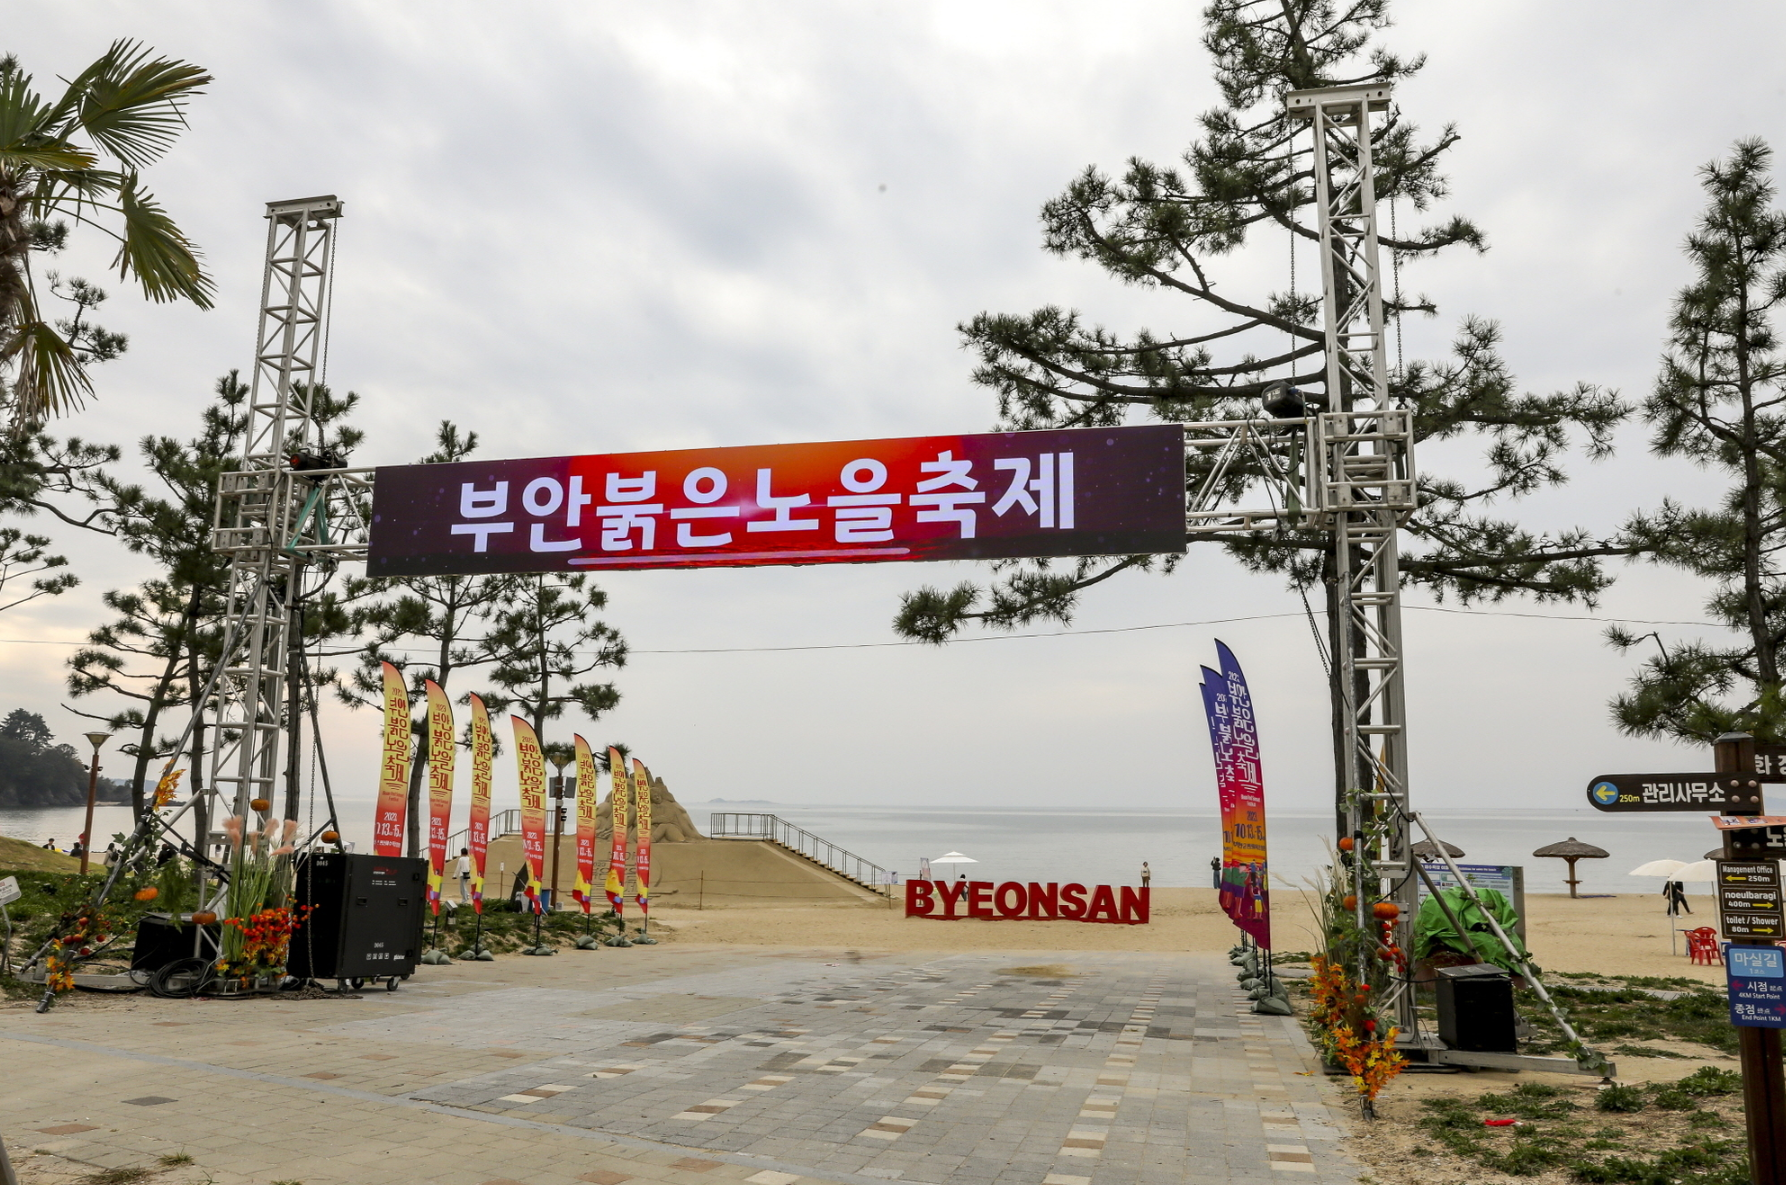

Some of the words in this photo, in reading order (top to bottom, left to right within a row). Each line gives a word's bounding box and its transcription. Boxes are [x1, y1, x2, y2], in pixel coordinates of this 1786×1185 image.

[450, 450, 1075, 553] 부안붉은노을축제
[1619, 794, 1640, 802] 250m
[1642, 782, 1726, 804] 관리사무소
[1722, 866, 1756, 874] Management
[1725, 891, 1777, 901] noeulbaragi
[905, 880, 1150, 924] BYEONSAN
[1726, 916, 1746, 924] toilet
[1751, 916, 1778, 925] Shower
[1734, 952, 1778, 968] 마실길
[1747, 981, 1767, 992] 시점
[1734, 1004, 1755, 1014] 종점
